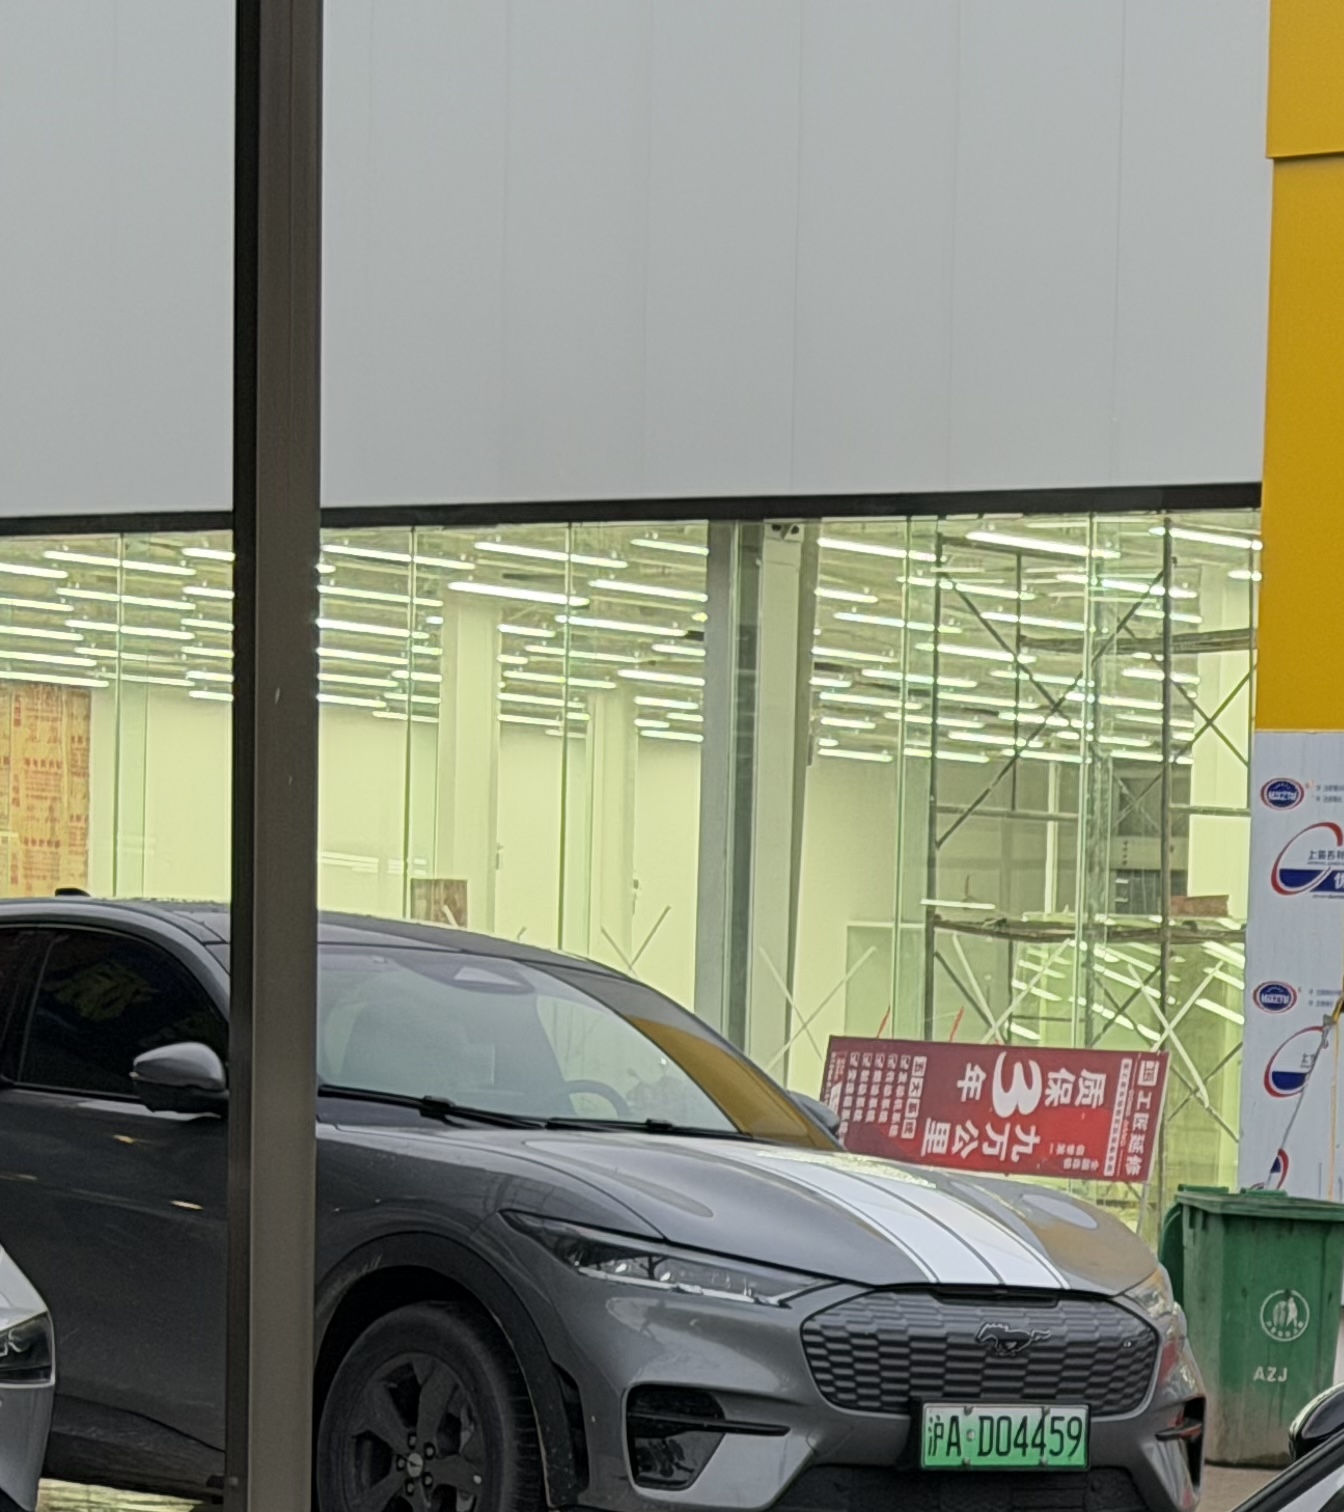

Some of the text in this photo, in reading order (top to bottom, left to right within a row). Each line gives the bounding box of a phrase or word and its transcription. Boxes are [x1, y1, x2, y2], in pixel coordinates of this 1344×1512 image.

[921, 1118, 1040, 1163] 九万公里
[1253, 1365, 1288, 1383] AZJ
[979, 1414, 1083, 1458] D04459
